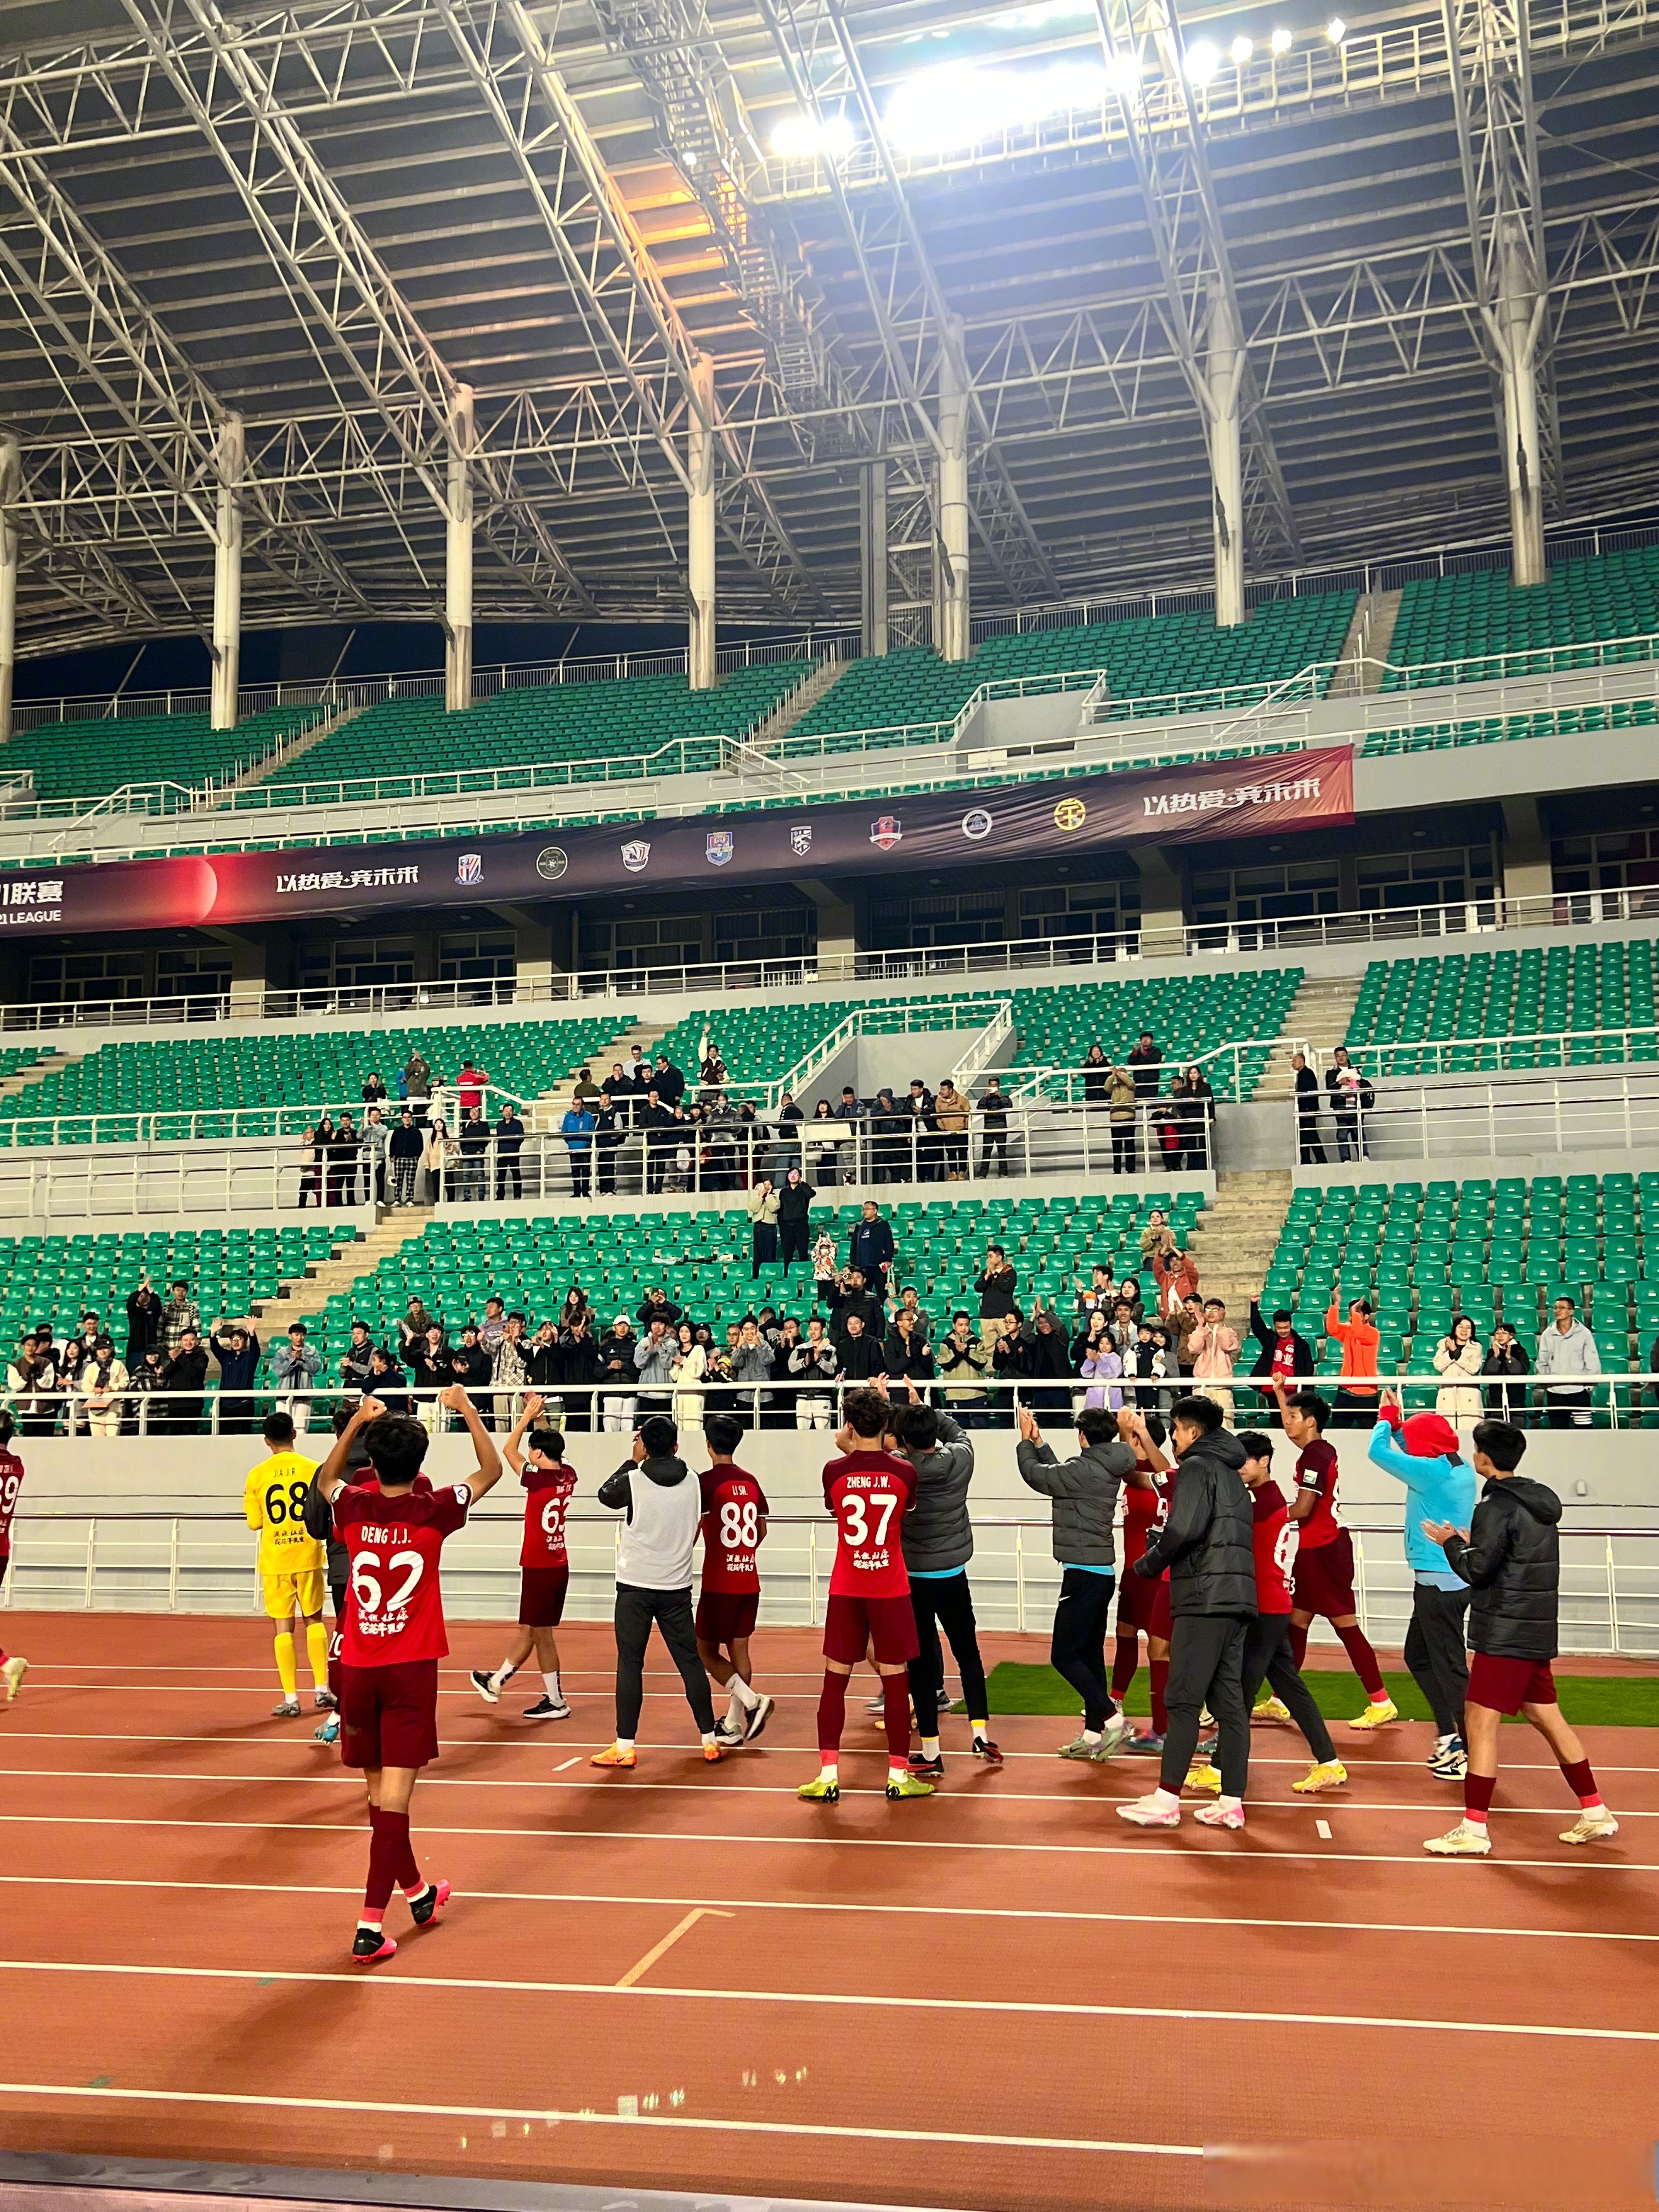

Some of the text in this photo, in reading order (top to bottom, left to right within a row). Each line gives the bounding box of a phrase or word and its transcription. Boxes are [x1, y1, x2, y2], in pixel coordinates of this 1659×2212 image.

[0, 881, 64, 906] 1联赛
[9, 910, 61, 924] LEAGUE
[847, 1476, 891, 1488] ZHENG J.W.
[266, 1481, 308, 1524] 68
[361, 1525, 412, 1544] DENG J.J.
[720, 1502, 758, 1548] 88
[842, 1494, 898, 1546] 37
[352, 1550, 425, 1613] 62
